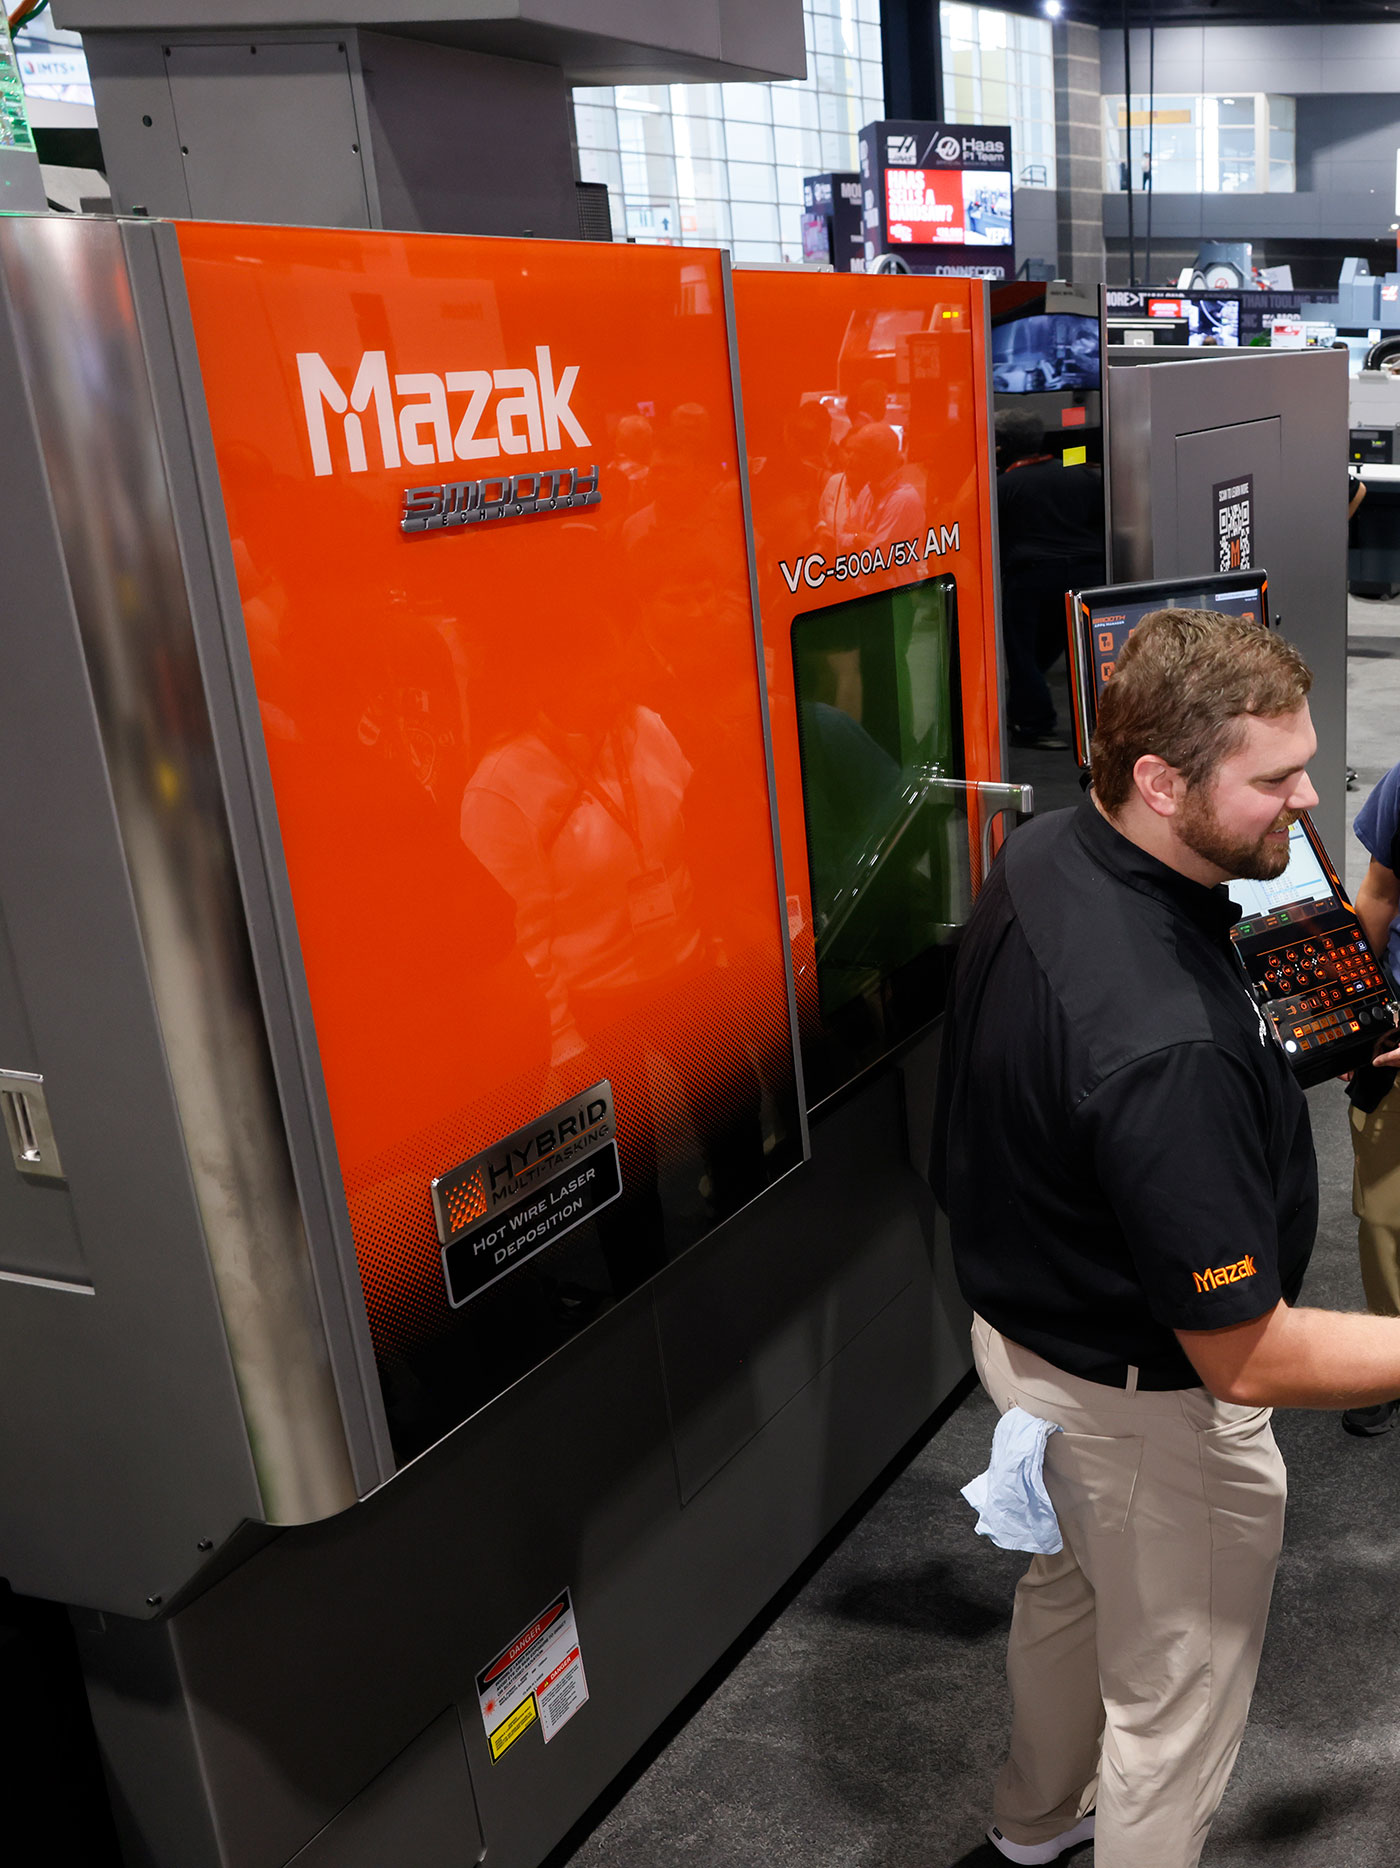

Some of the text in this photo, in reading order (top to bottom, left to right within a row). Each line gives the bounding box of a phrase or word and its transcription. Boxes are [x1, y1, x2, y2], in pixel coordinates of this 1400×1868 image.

[962, 138, 1004, 152] Haas
[963, 153, 1005, 161] F1 Team
[888, 170, 925, 189] HAAS
[925, 189, 936, 204] A
[296, 345, 592, 476] Mazak
[403, 465, 600, 519] SMOOTH
[423, 494, 590, 529] TECHNOLOGY
[778, 521, 961, 594] VC-500A/5X AM
[487, 1098, 608, 1191] HYBRID
[493, 1124, 609, 1205] MULTI-TASKING
[473, 1168, 596, 1256] HOT WIRE LASER
[495, 1198, 584, 1265] DEPOSITION
[1192, 1254, 1257, 1293] Mazak
[508, 1622, 541, 1660] DANGER
[549, 1654, 571, 1681] DANGER
